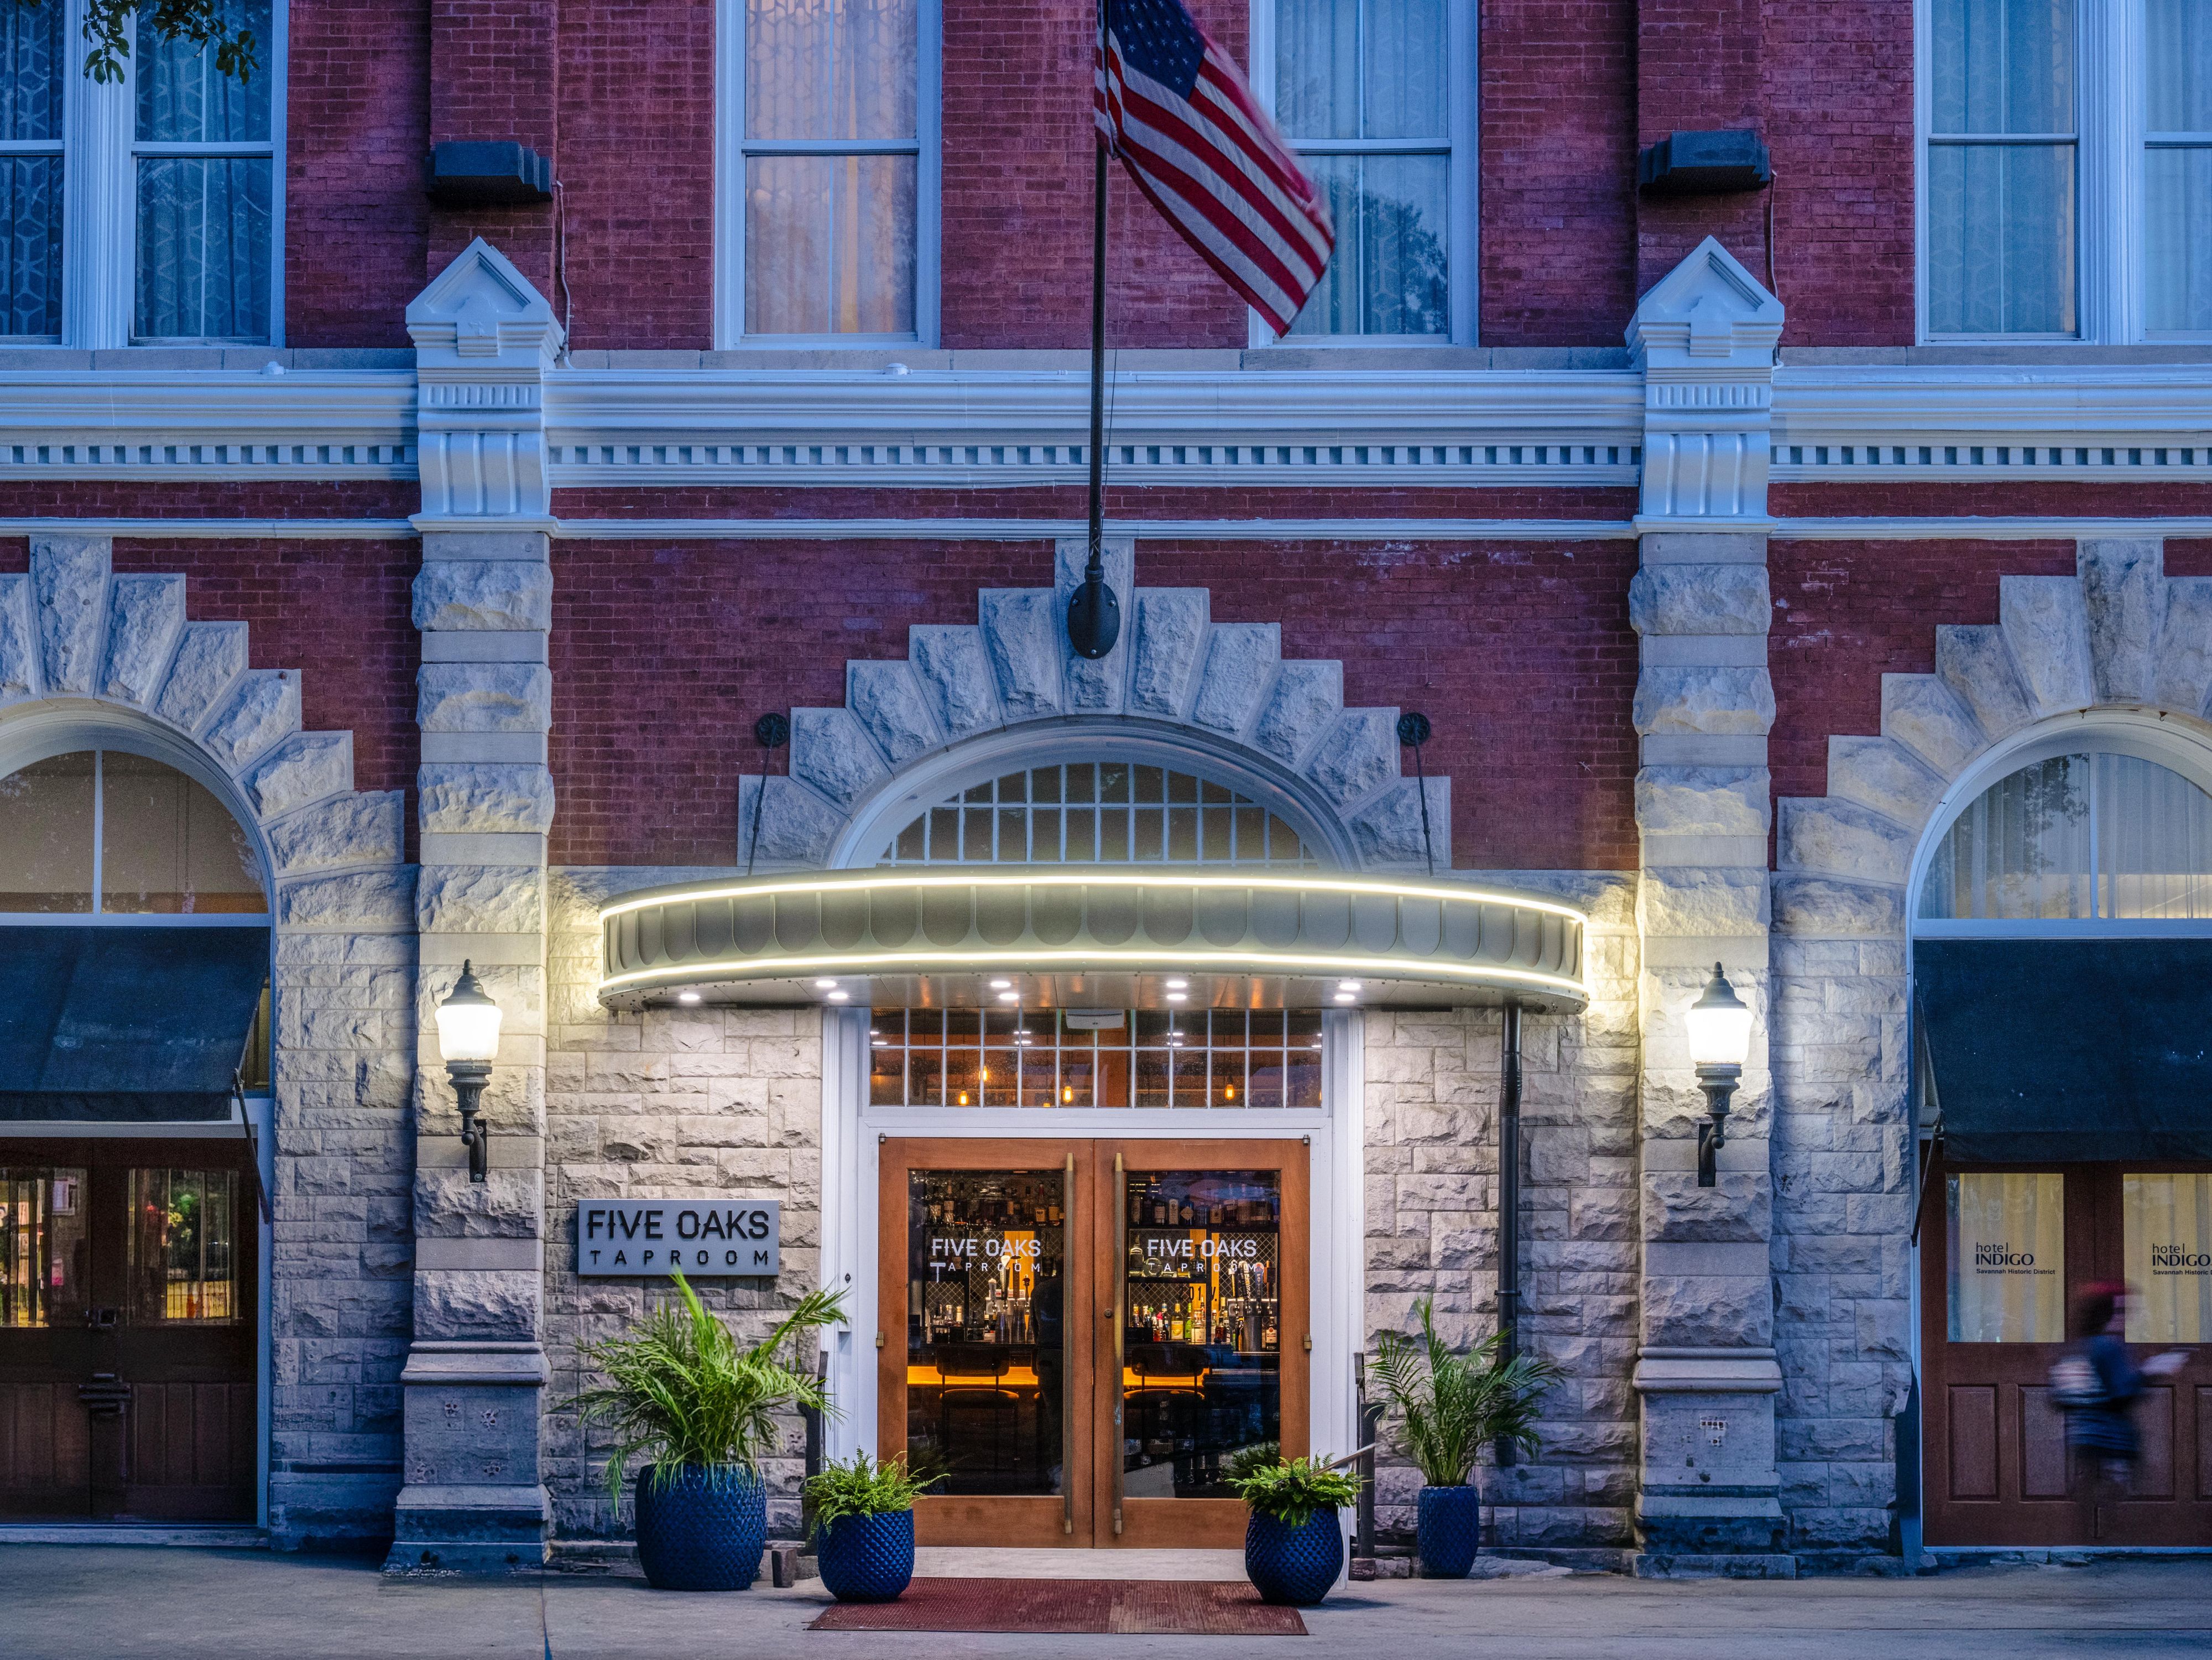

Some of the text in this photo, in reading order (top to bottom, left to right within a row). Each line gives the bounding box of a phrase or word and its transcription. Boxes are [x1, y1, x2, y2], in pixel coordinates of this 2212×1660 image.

[587, 1210, 769, 1239] FIVE OAKS
[932, 1239, 1041, 1257] FIVE OAKS
[1147, 1239, 1256, 1257] FIVE OAKS
[1976, 1242, 2008, 1252] hotel
[2152, 1243, 2184, 1253] hotel
[590, 1250, 768, 1264] TAPROOM
[1976, 1253, 2034, 1266] INDIGO
[2152, 1254, 2211, 1266] INDIGO
[930, 1262, 1041, 1283] TAPROOM
[1147, 1263, 1256, 1272] TAPROOM
